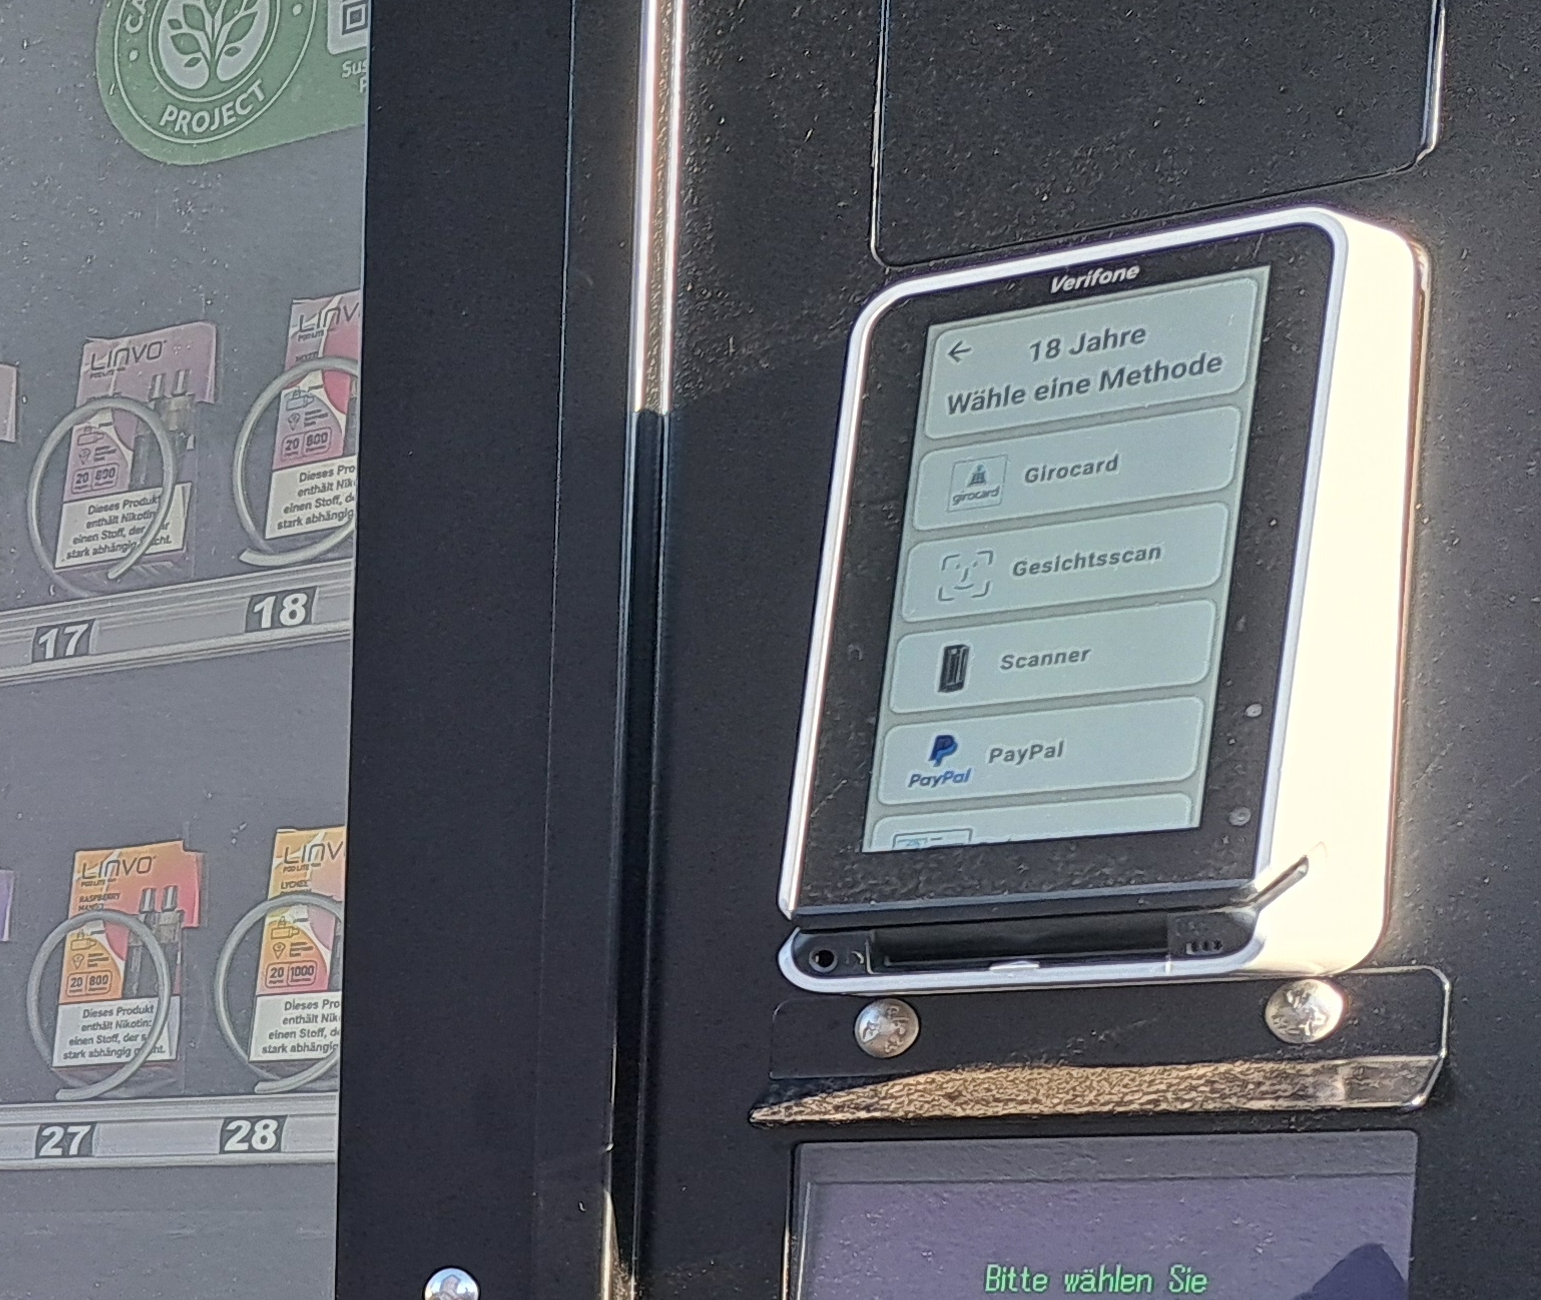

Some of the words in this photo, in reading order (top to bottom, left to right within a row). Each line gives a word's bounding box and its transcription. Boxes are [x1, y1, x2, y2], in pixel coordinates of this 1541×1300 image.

[159, 79, 265, 135] PROJECT
[1049, 265, 1140, 294] Verifone
[1029, 339, 1061, 362] 18
[1069, 325, 1146, 356] Jahre
[946, 382, 1025, 416] Wähle
[1034, 375, 1090, 400] eine
[1098, 352, 1223, 391] Methode
[1024, 454, 1119, 484] Girocard
[952, 484, 1000, 506] girocard
[1012, 542, 1162, 578] Gesichtsscan
[252, 593, 308, 629] 18
[38, 624, 89, 658] 17
[1000, 646, 1091, 672] Scanner
[989, 741, 1064, 766] PayPal
[908, 768, 971, 789] PayPal
[69, 975, 83, 988] 20
[269, 967, 284, 979] 20
[82, 1007, 115, 1019] Dieses
[63, 1048, 86, 1060] stark
[69, 1034, 95, 1046] einen
[39, 1125, 92, 1156] 27
[224, 1118, 279, 1151] 28
[985, 1264, 1048, 1293] Bitte
[1065, 1264, 1153, 1293] wählen
[1169, 1264, 1207, 1293] Sie
